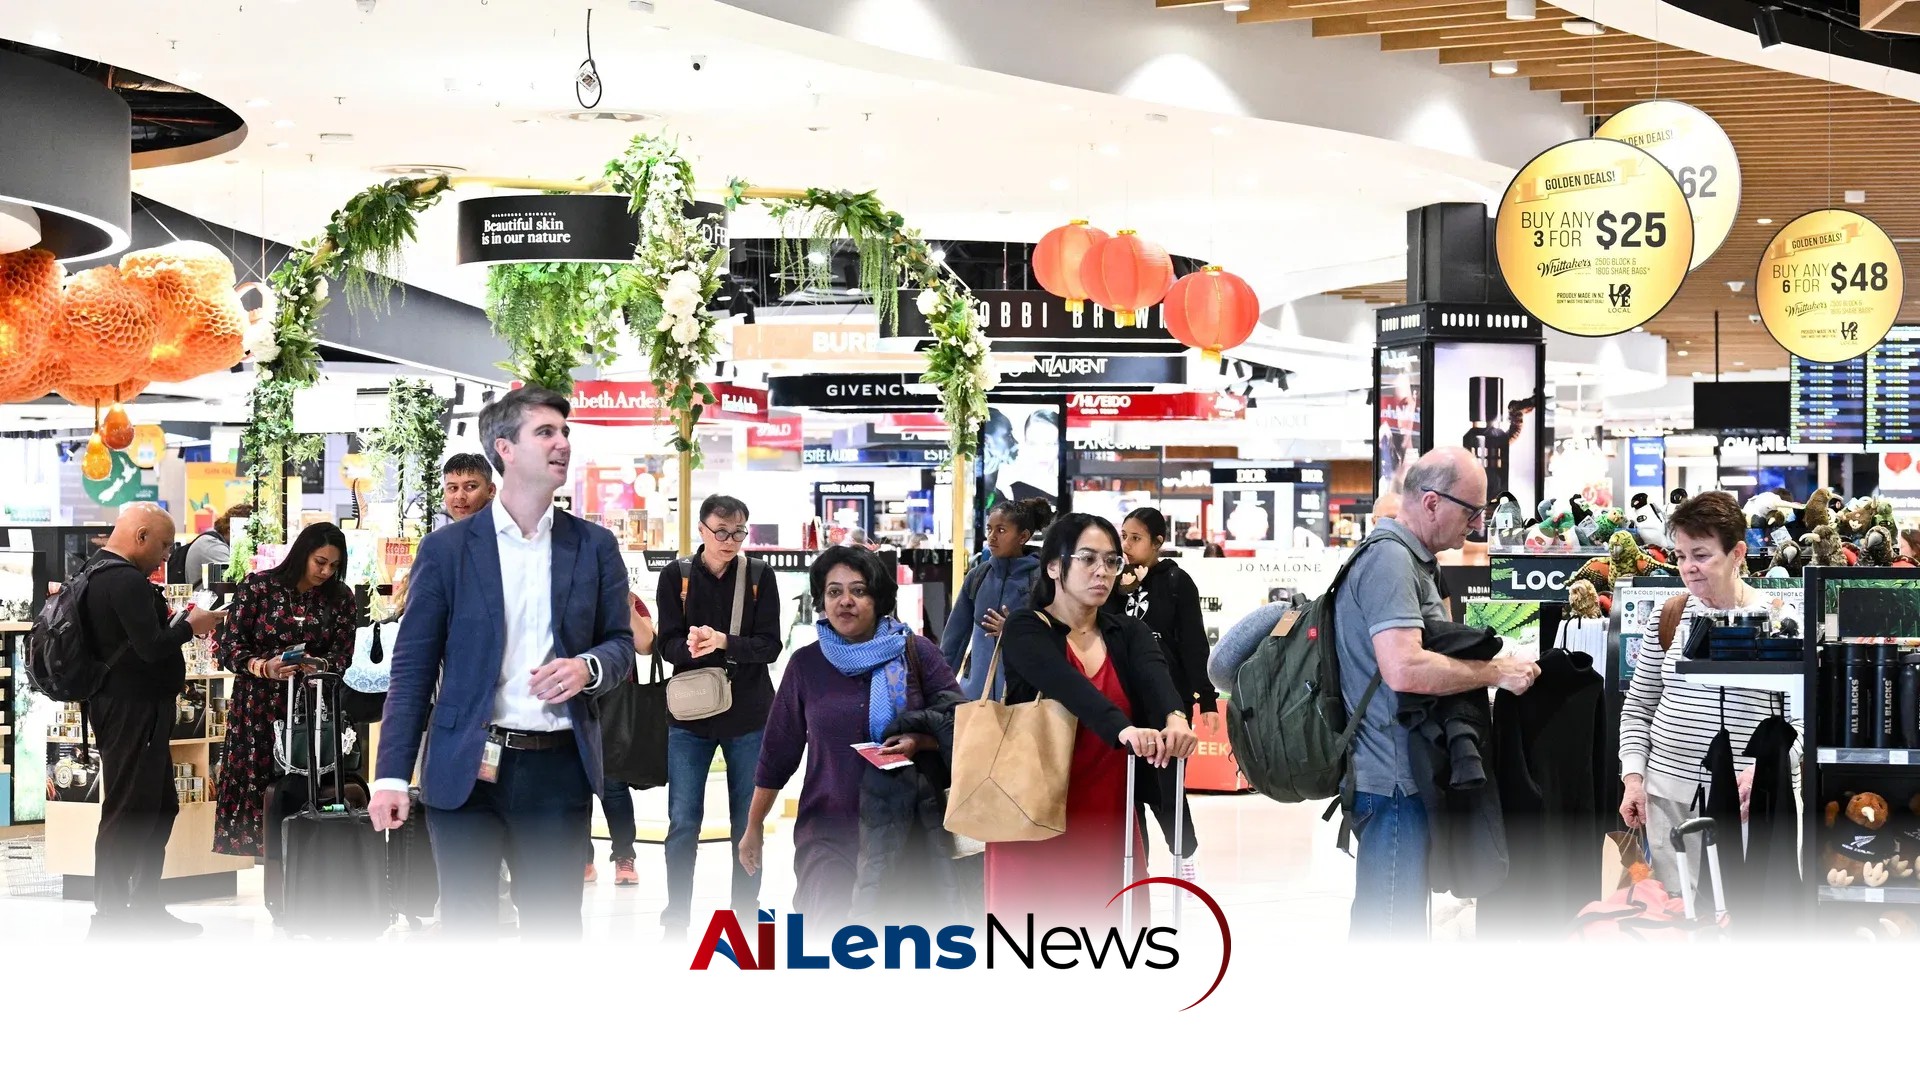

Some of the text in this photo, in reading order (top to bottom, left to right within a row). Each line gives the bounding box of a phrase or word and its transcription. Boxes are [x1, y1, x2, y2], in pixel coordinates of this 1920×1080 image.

[1620, 129, 1673, 147] LDEN DEALS!
[1545, 170, 1616, 191] GOLDEN DEALS!
[1665, 164, 1718, 199] 62
[483, 216, 565, 232] Beautiful skin
[1521, 210, 1667, 250] BUY ANY $25
[481, 231, 571, 245] is in our nature
[1533, 230, 1582, 248] 3 FOR
[1791, 233, 1843, 250] GOLDEN DEALS!
[1536, 257, 1592, 278] Whittaker's
[1608, 266, 1630, 275] SHARE
[1612, 257, 1631, 266] BLOCK
[1773, 262, 1888, 294] BUY ANY $48
[1782, 279, 1820, 293] 6 FOR
[979, 301, 1168, 329] OBBI BRW
[1236, 563, 1322, 573] JO MALONE
[1851, 679, 1859, 734] ALL BLACKS
[1884, 680, 1892, 735] ALL BLACKS
[1191, 741, 1229, 756] EEK
